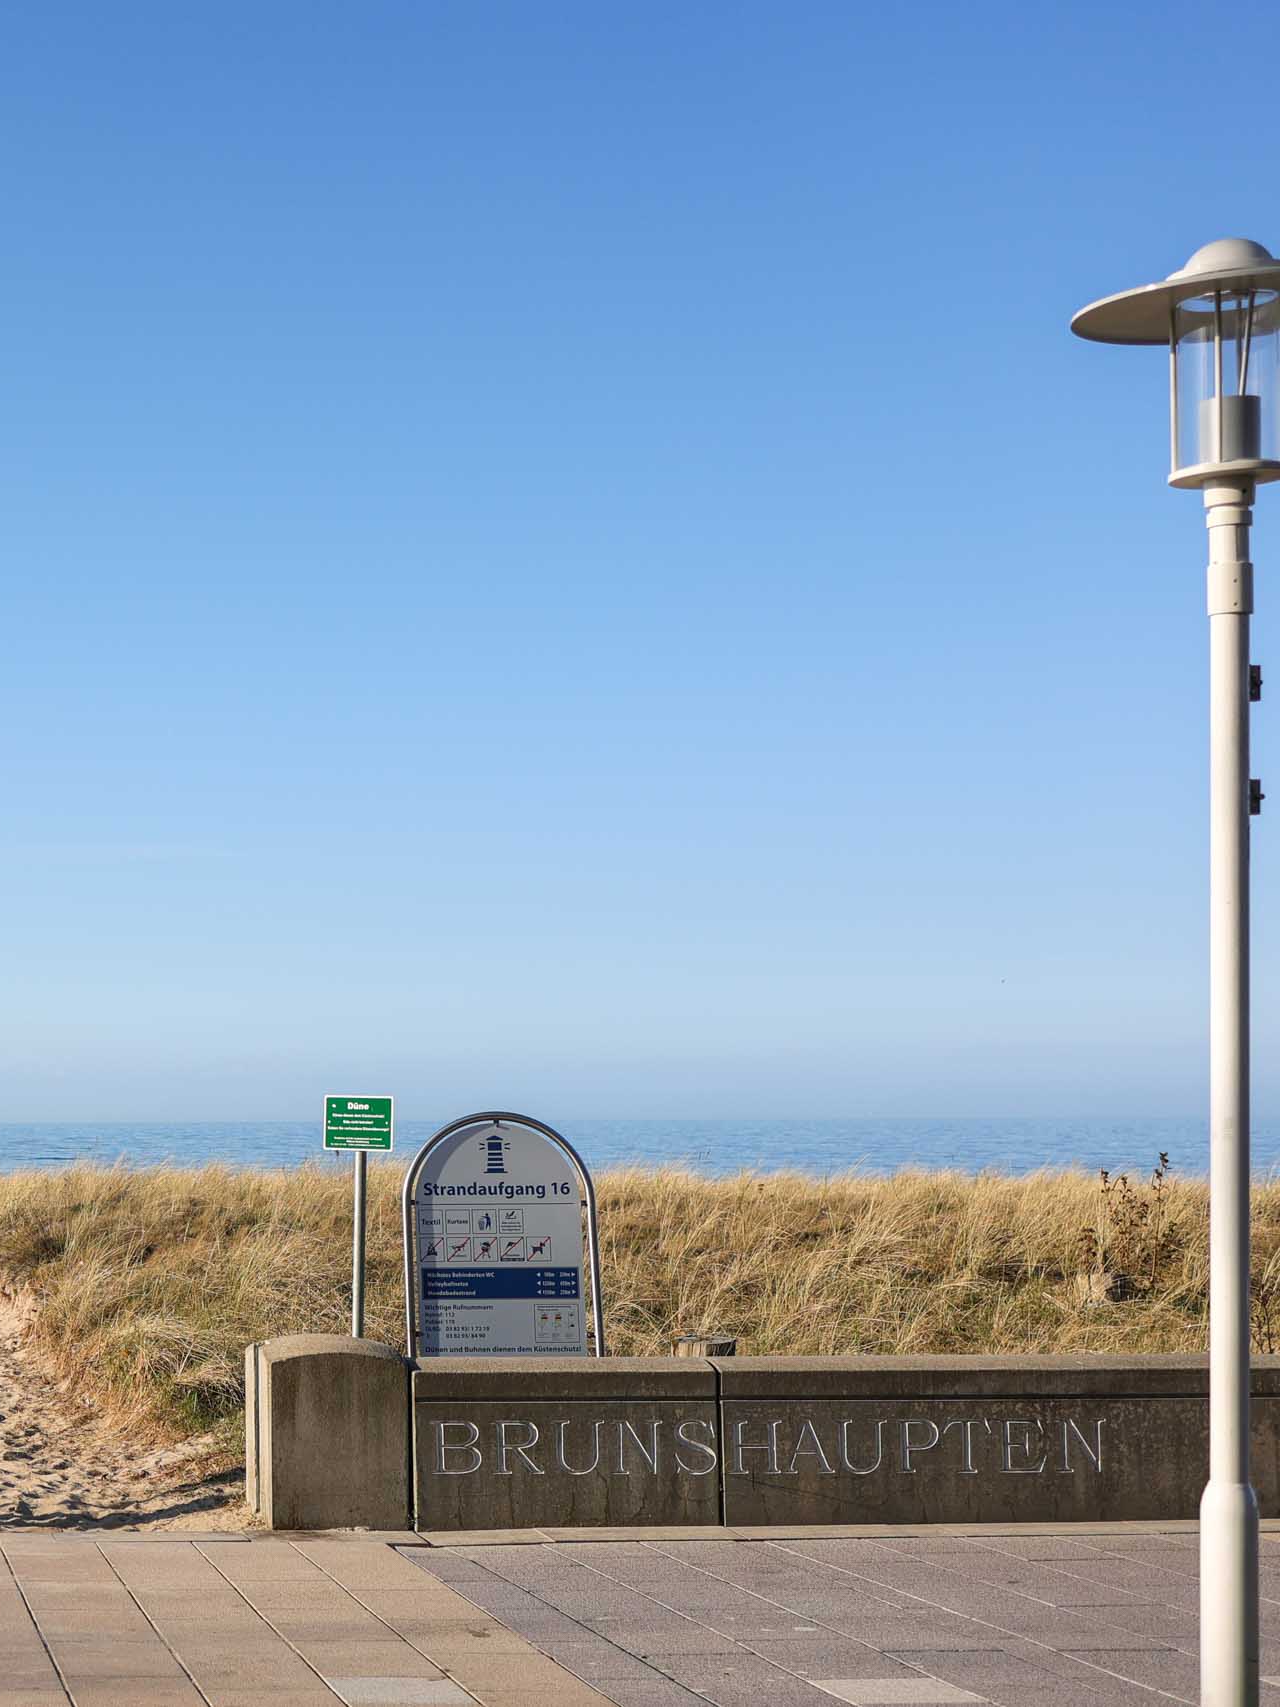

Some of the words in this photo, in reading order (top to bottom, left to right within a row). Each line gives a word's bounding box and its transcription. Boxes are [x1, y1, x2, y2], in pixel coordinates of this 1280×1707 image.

[423, 1182, 546, 1199] Strandaufgang
[551, 1182, 570, 1195] 16
[425, 1345, 448, 1353] Dünen
[449, 1345, 463, 1353] und
[492, 1344, 516, 1352] dienen
[517, 1344, 532, 1352] dem
